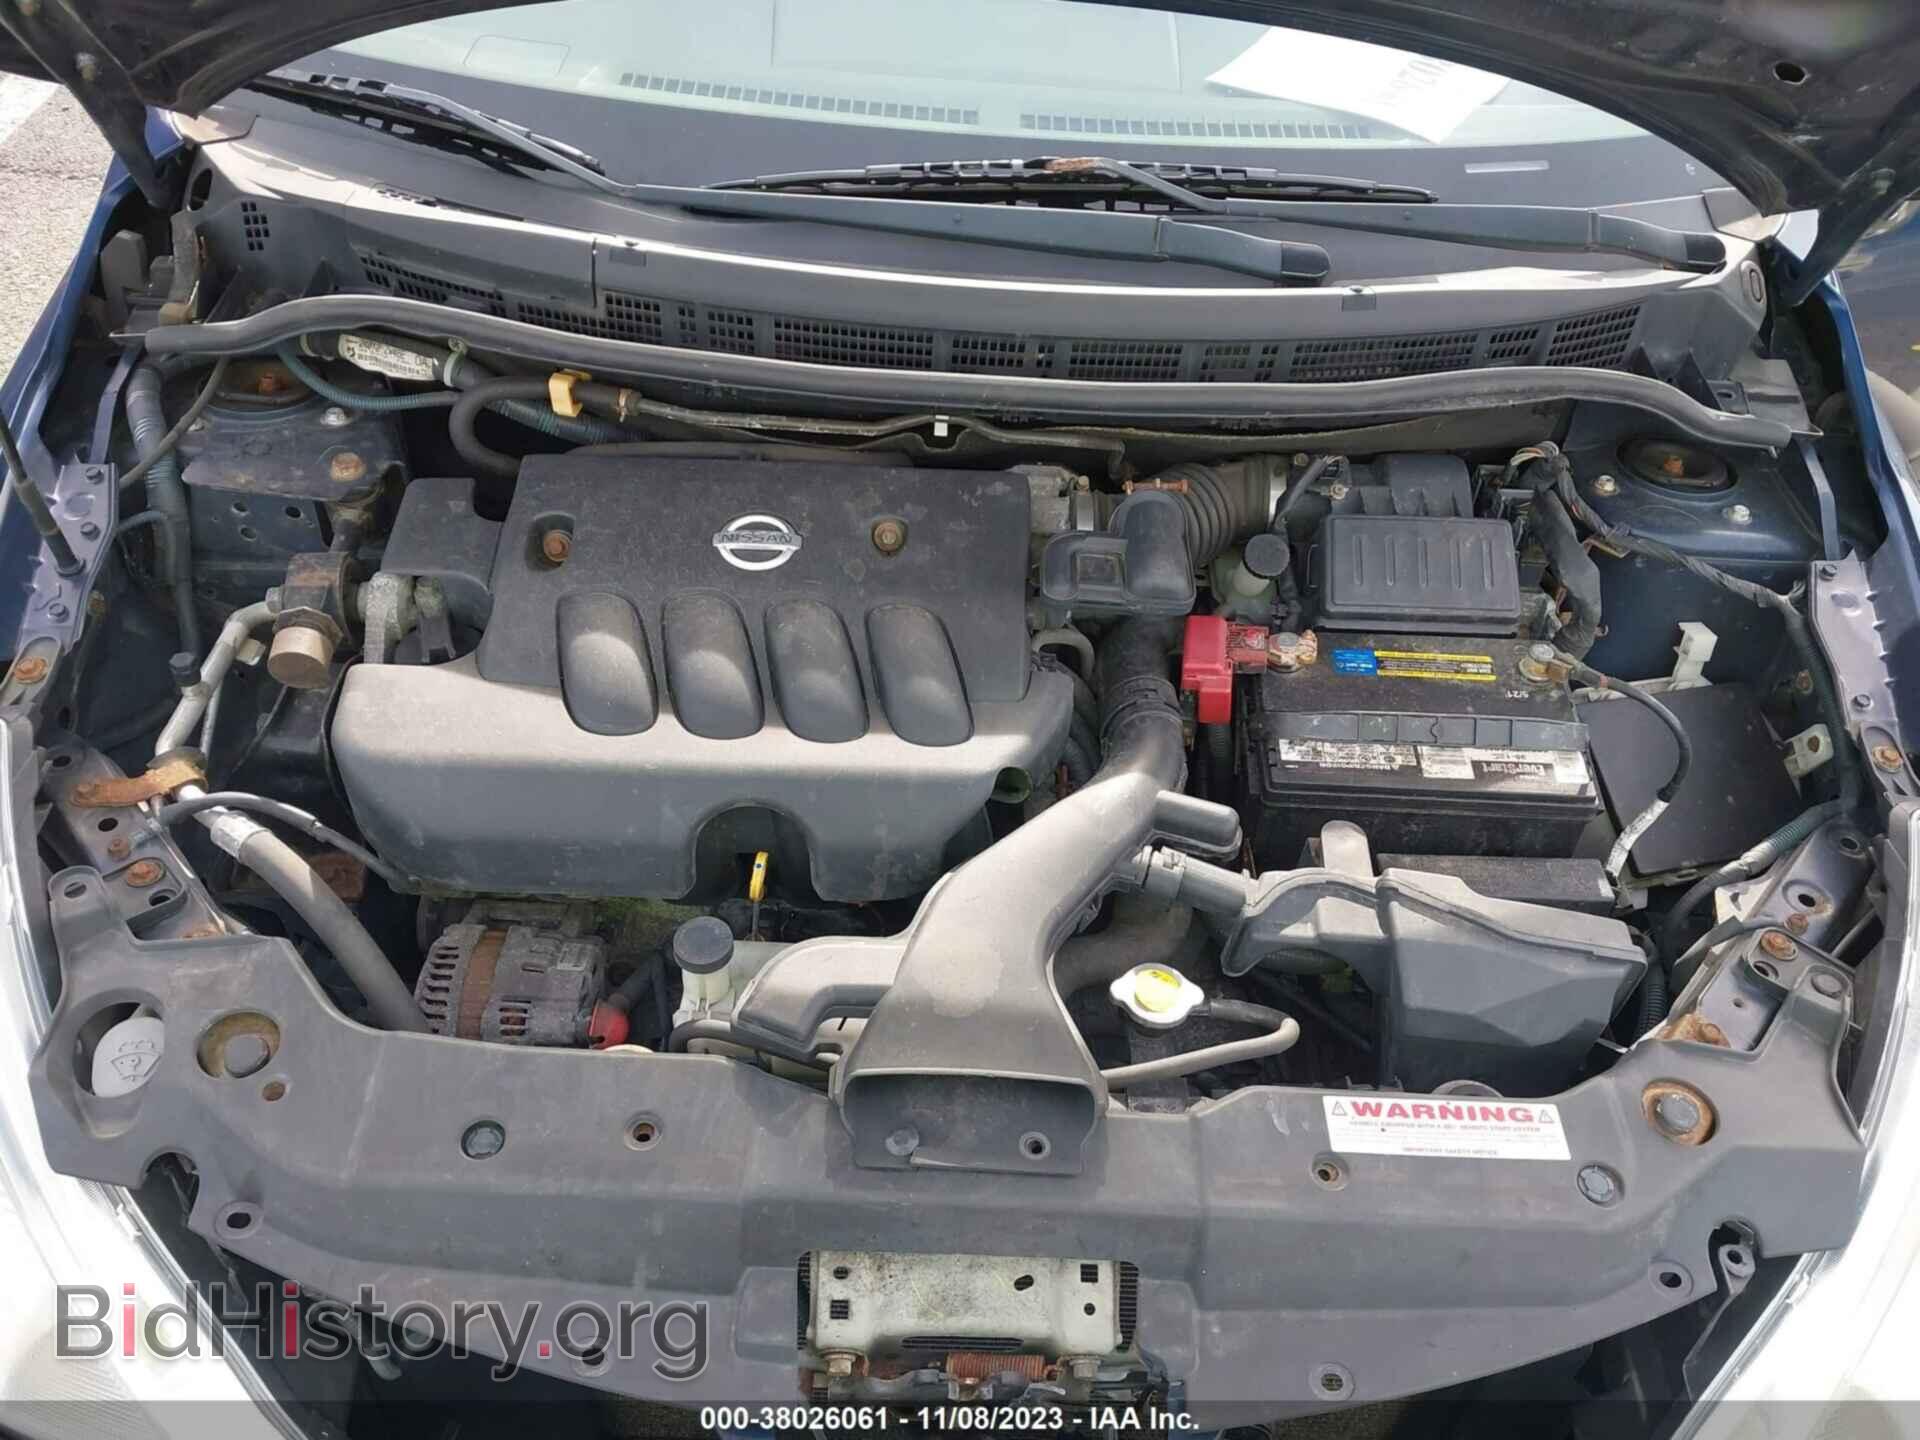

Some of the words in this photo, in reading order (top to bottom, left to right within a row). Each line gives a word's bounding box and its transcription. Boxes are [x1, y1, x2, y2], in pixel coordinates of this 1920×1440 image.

[721, 532, 793, 545] NISSAN
[1481, 761, 1546, 777] EverStart
[1351, 1101, 1534, 1123] WARNING
